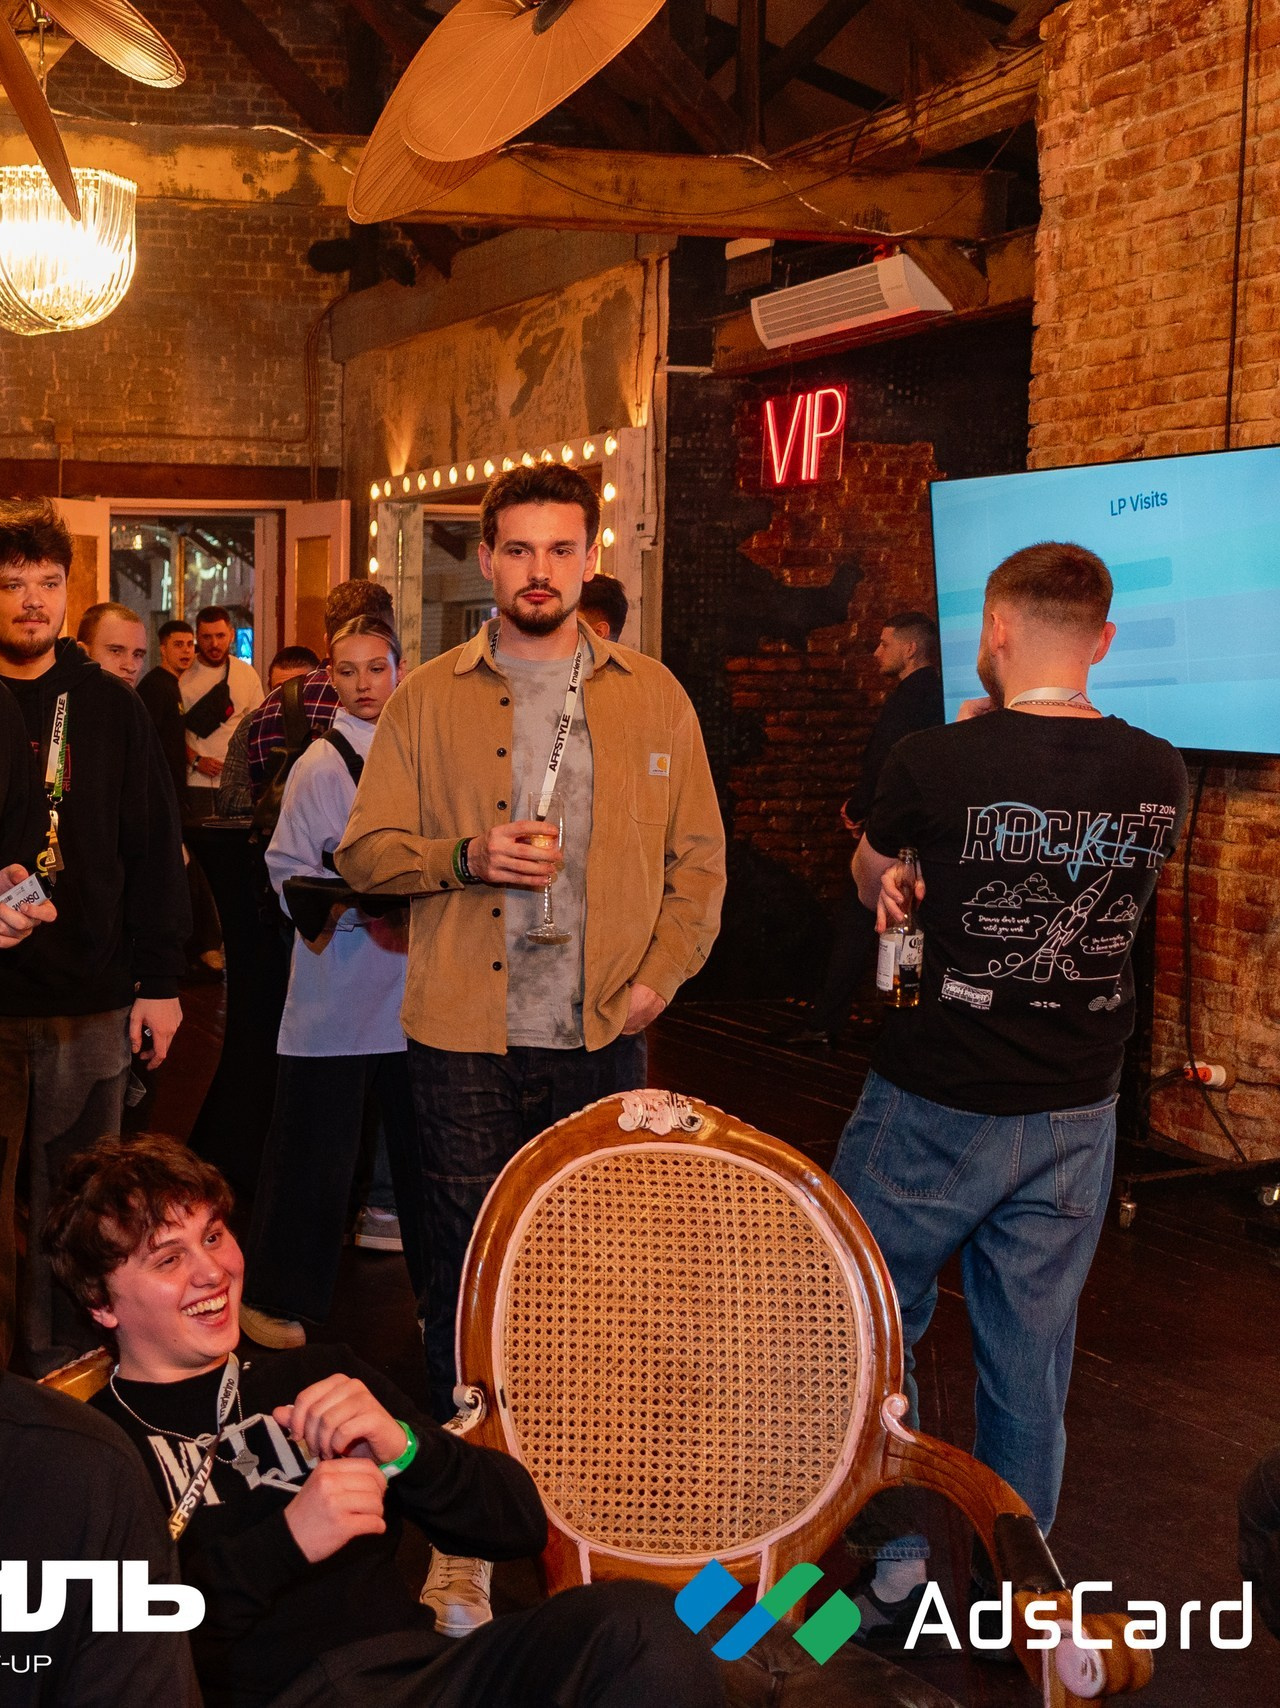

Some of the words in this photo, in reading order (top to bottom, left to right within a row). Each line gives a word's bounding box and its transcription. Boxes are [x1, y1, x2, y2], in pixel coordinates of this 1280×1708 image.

[766, 388, 844, 483] VIP
[1110, 498, 1127, 516] LP
[1130, 491, 1168, 512] Visits
[571, 651, 583, 684] marlerino
[53, 698, 66, 745] AFFSTYLE
[549, 713, 571, 772] AFFSTYLE
[1140, 803, 1158, 813] EST
[1159, 804, 1176, 816] 2014
[961, 807, 1174, 868] ROCKET
[219, 1378, 234, 1418] marlerino
